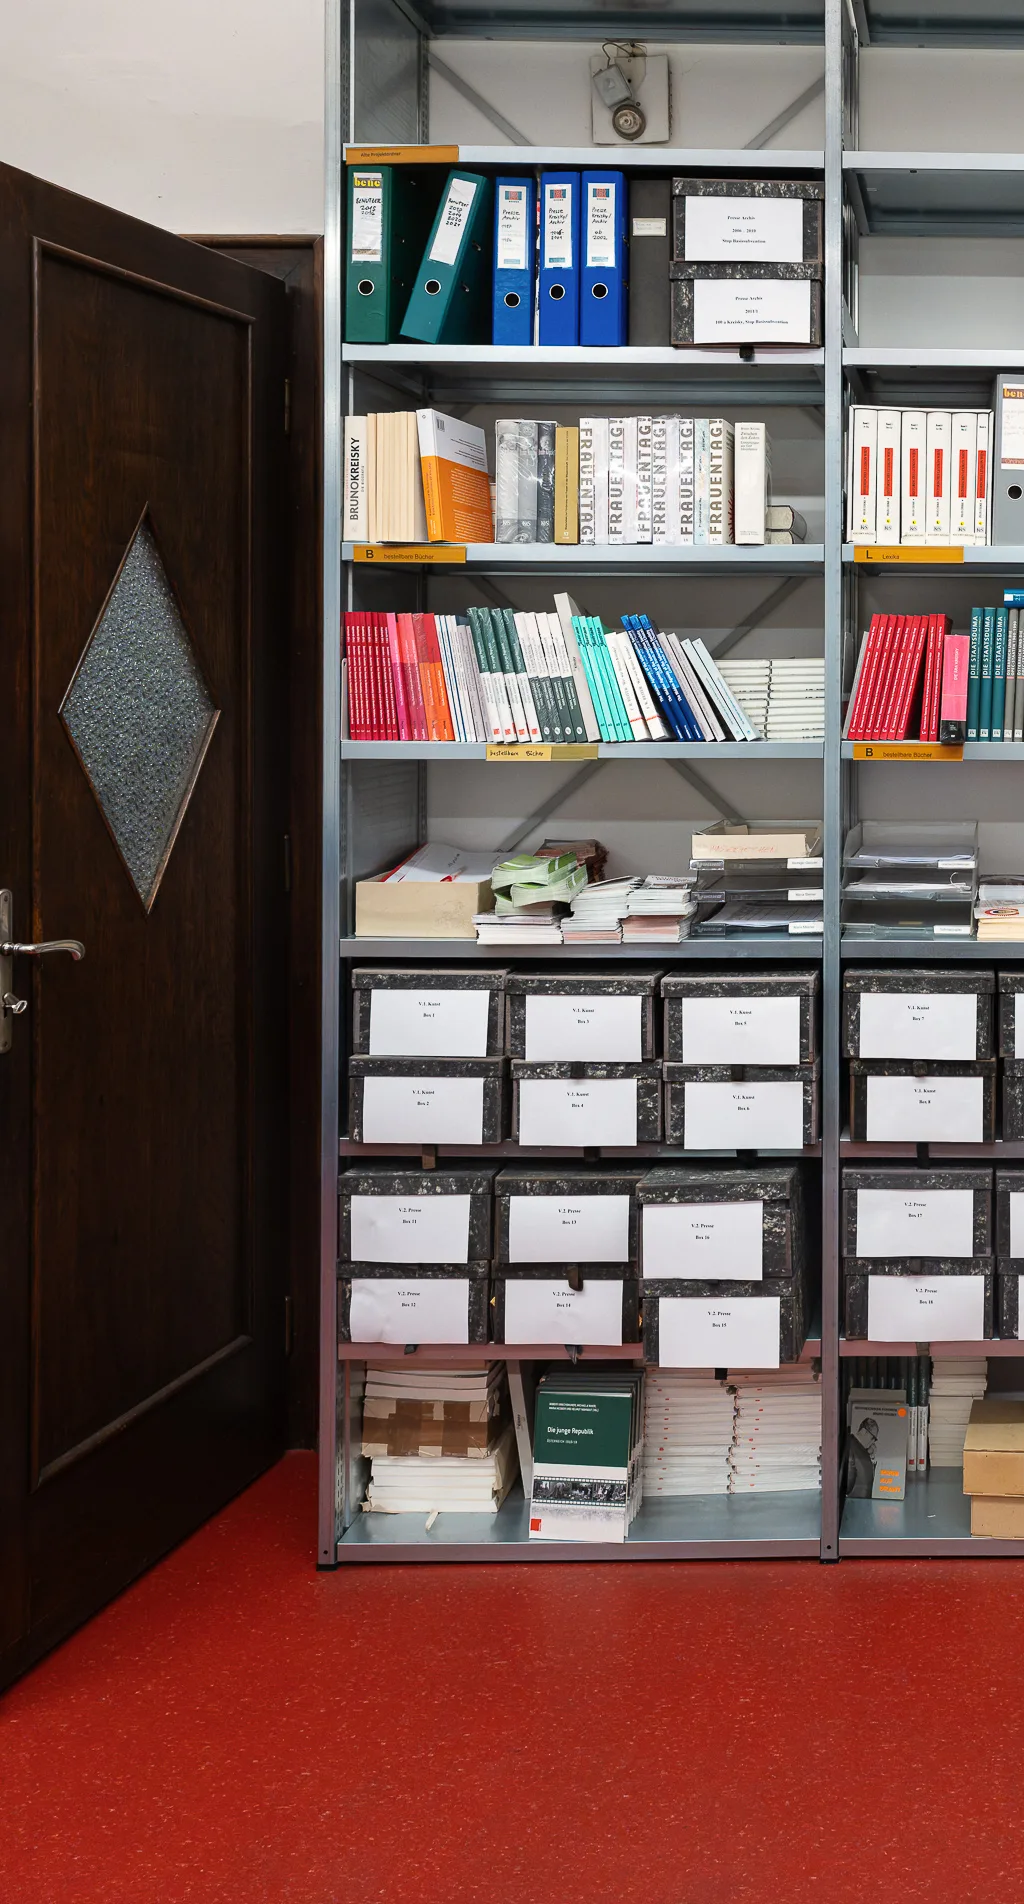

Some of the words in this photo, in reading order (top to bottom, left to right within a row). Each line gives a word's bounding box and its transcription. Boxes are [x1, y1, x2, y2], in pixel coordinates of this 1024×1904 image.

[354, 176, 381, 188] bene
[350, 437, 360, 520] BRUNOKREISKY
[709, 419, 723, 536] FRAUENTAG!
[366, 550, 374, 558] B
[866, 550, 873, 559] L
[866, 748, 873, 757] B
[556, 1427, 570, 1435] junge
